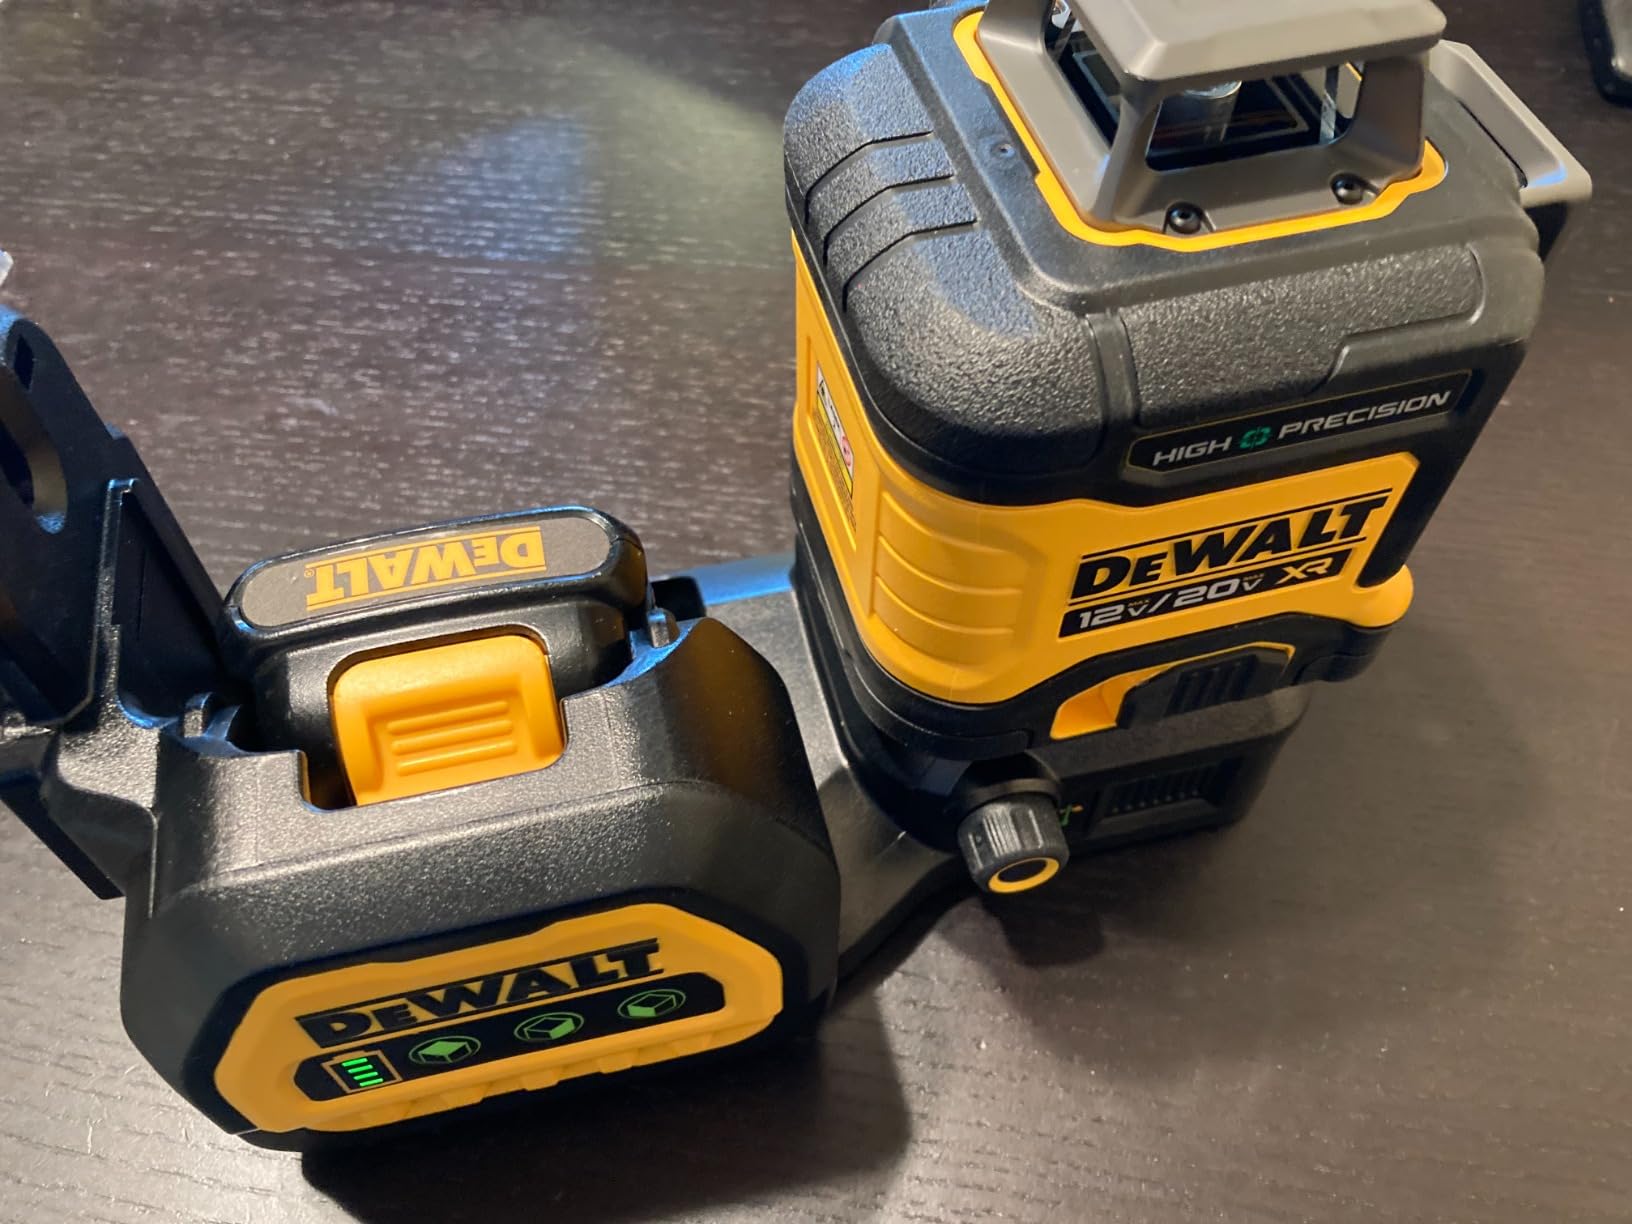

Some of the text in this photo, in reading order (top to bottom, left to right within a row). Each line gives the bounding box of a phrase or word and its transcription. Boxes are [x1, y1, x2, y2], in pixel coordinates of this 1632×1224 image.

[1152, 390, 1451, 466] HIGH PRECISION
[1274, 557, 1334, 585] XR
